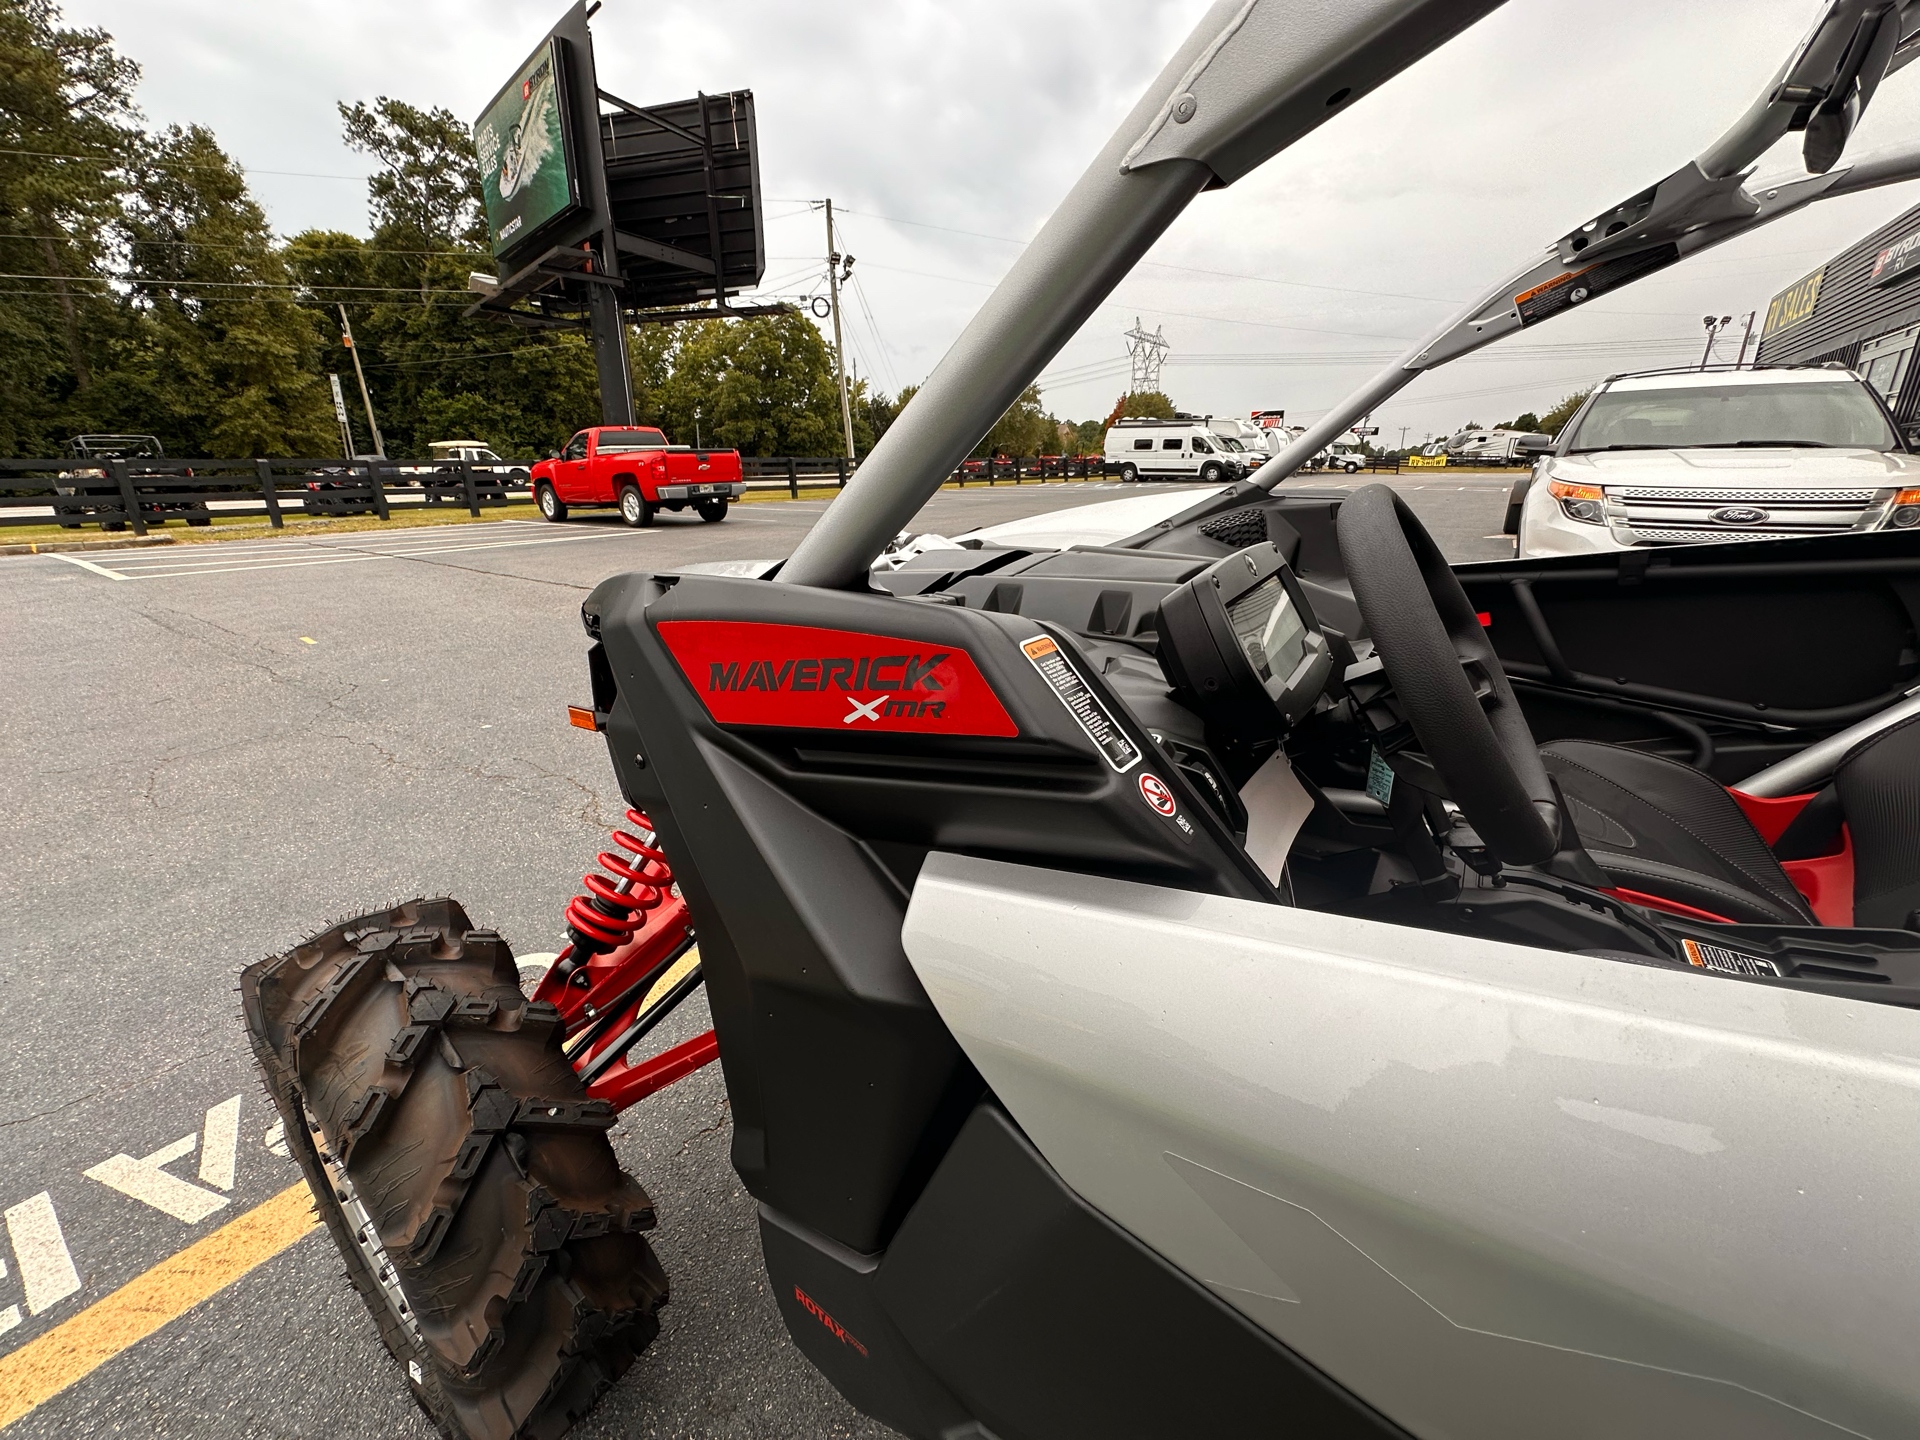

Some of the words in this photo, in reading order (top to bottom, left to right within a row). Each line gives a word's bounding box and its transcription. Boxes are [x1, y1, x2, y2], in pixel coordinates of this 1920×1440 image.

[477, 123, 493, 151] PARTS
[480, 133, 501, 165] SERVICE
[483, 155, 497, 180] SALES
[1884, 232, 1920, 264] BYRO
[1894, 253, 1909, 271] RV
[1536, 274, 1572, 293] WARNING
[1764, 295, 1784, 334] RV
[1779, 274, 1823, 328] SALES
[1421, 458, 1445, 466] SHOW!
[1722, 509, 1756, 520] Ford
[708, 653, 951, 693] MAVERICK
[794, 1287, 846, 1344] ROTAX
